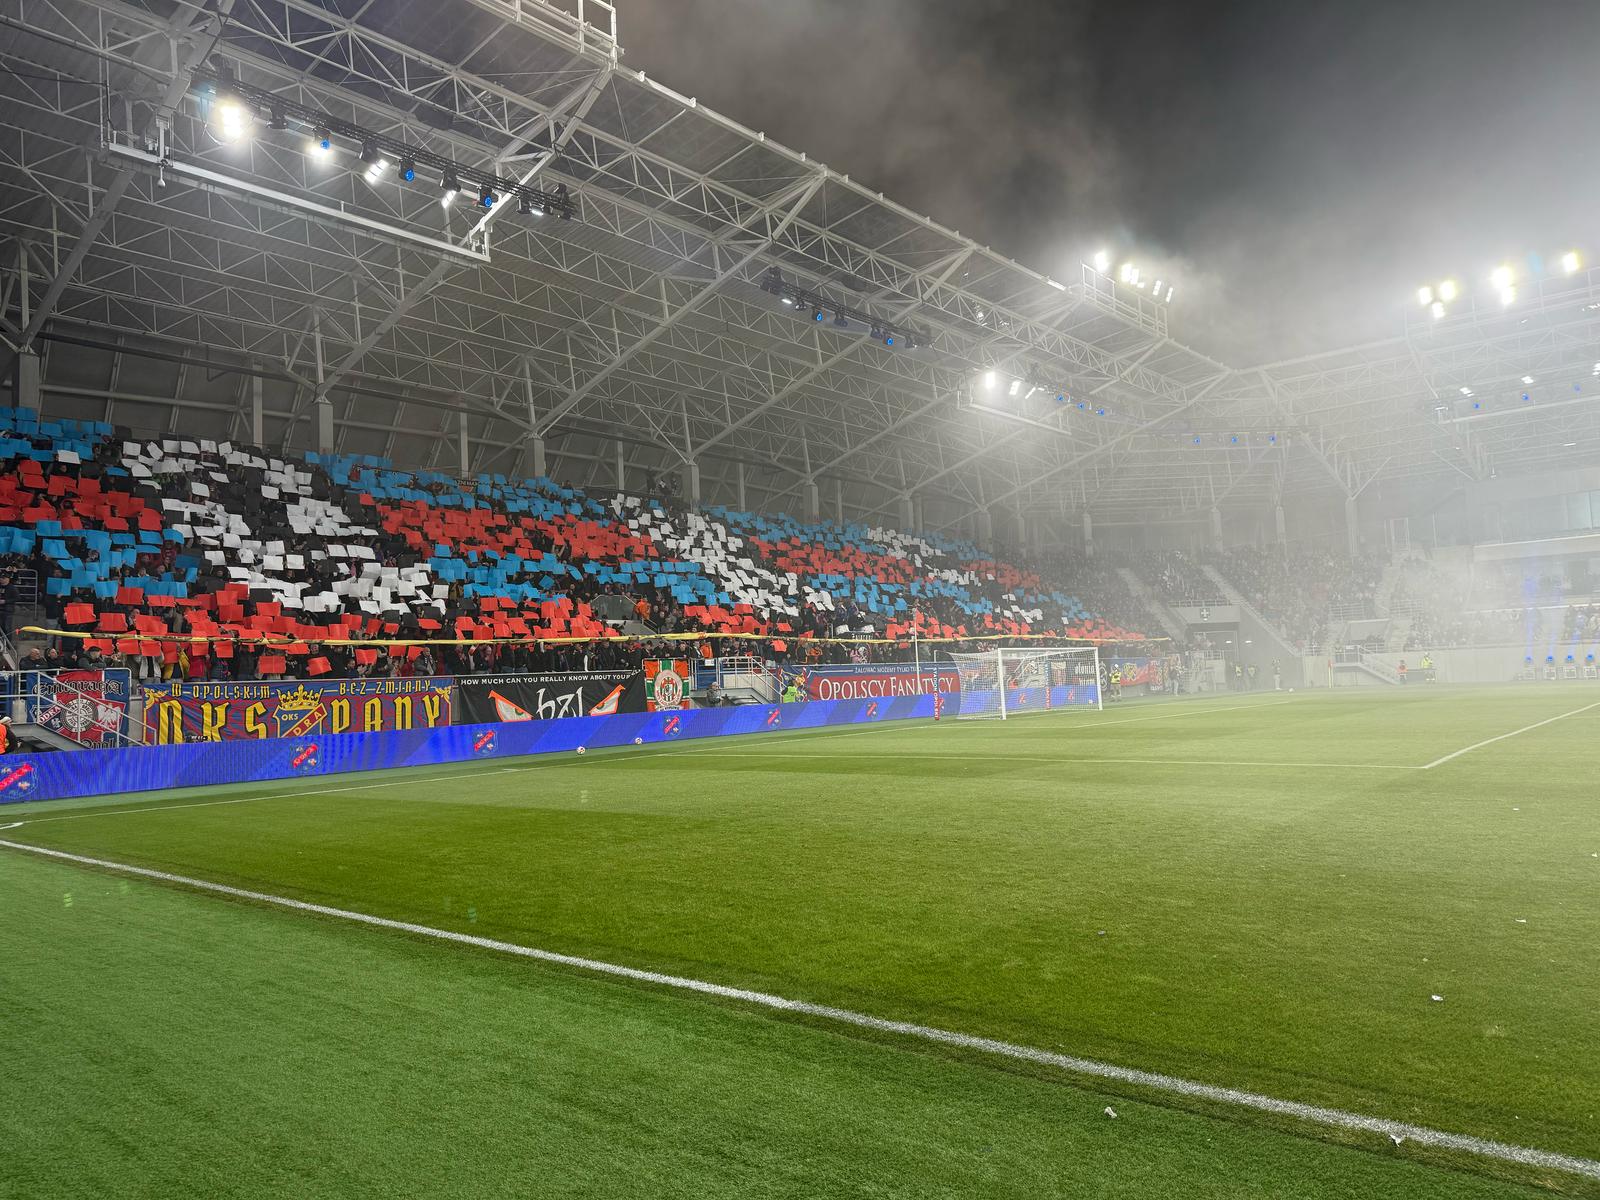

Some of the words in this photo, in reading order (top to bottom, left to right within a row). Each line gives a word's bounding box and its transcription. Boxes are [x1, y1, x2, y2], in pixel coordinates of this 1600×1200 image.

[819, 678, 886, 701] OPOLSCY
[281, 713, 299, 722] OKS
[292, 710, 323, 736] DRA
